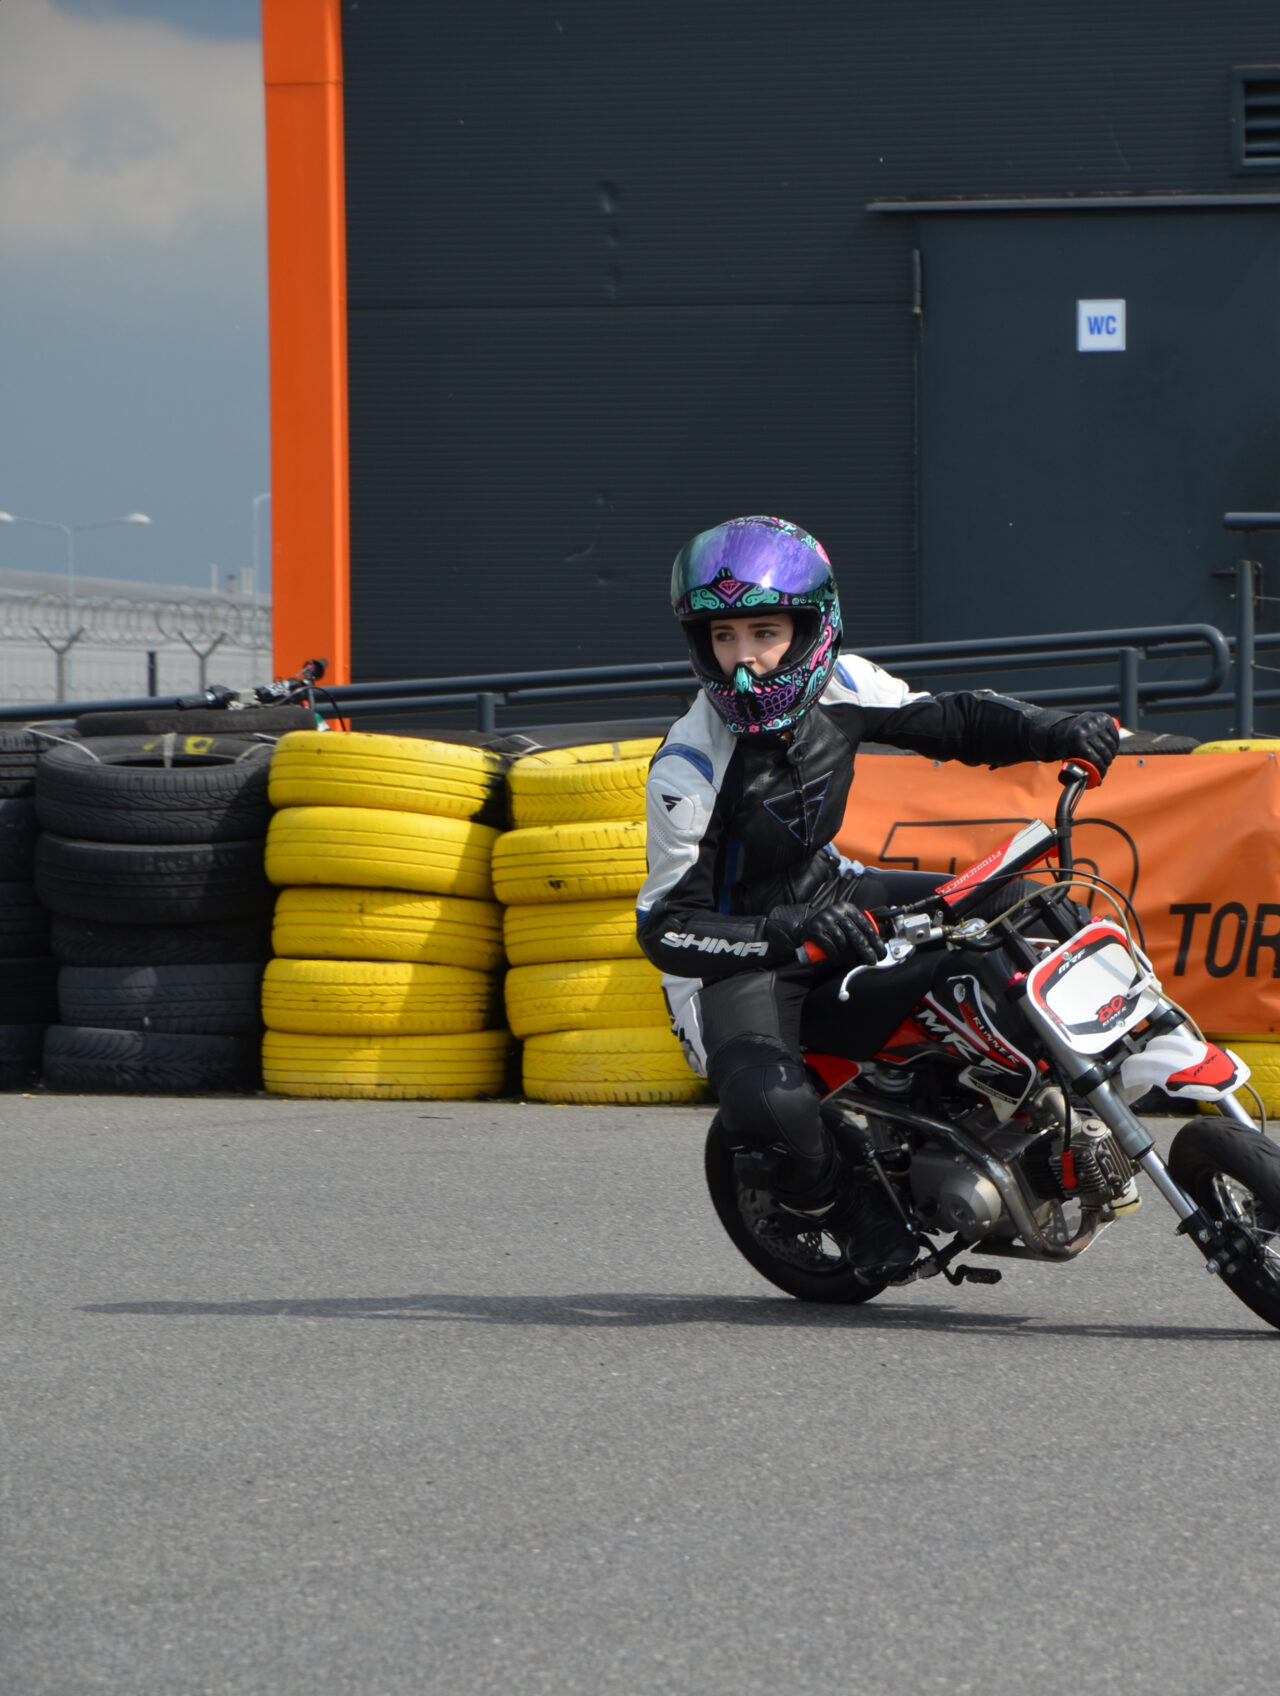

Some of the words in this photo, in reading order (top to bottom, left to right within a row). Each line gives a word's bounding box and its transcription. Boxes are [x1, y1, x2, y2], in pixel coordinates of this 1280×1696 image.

[1087, 314, 1117, 335] WC
[660, 931, 769, 957] SHIMA
[916, 1008, 1025, 1077] MRF
